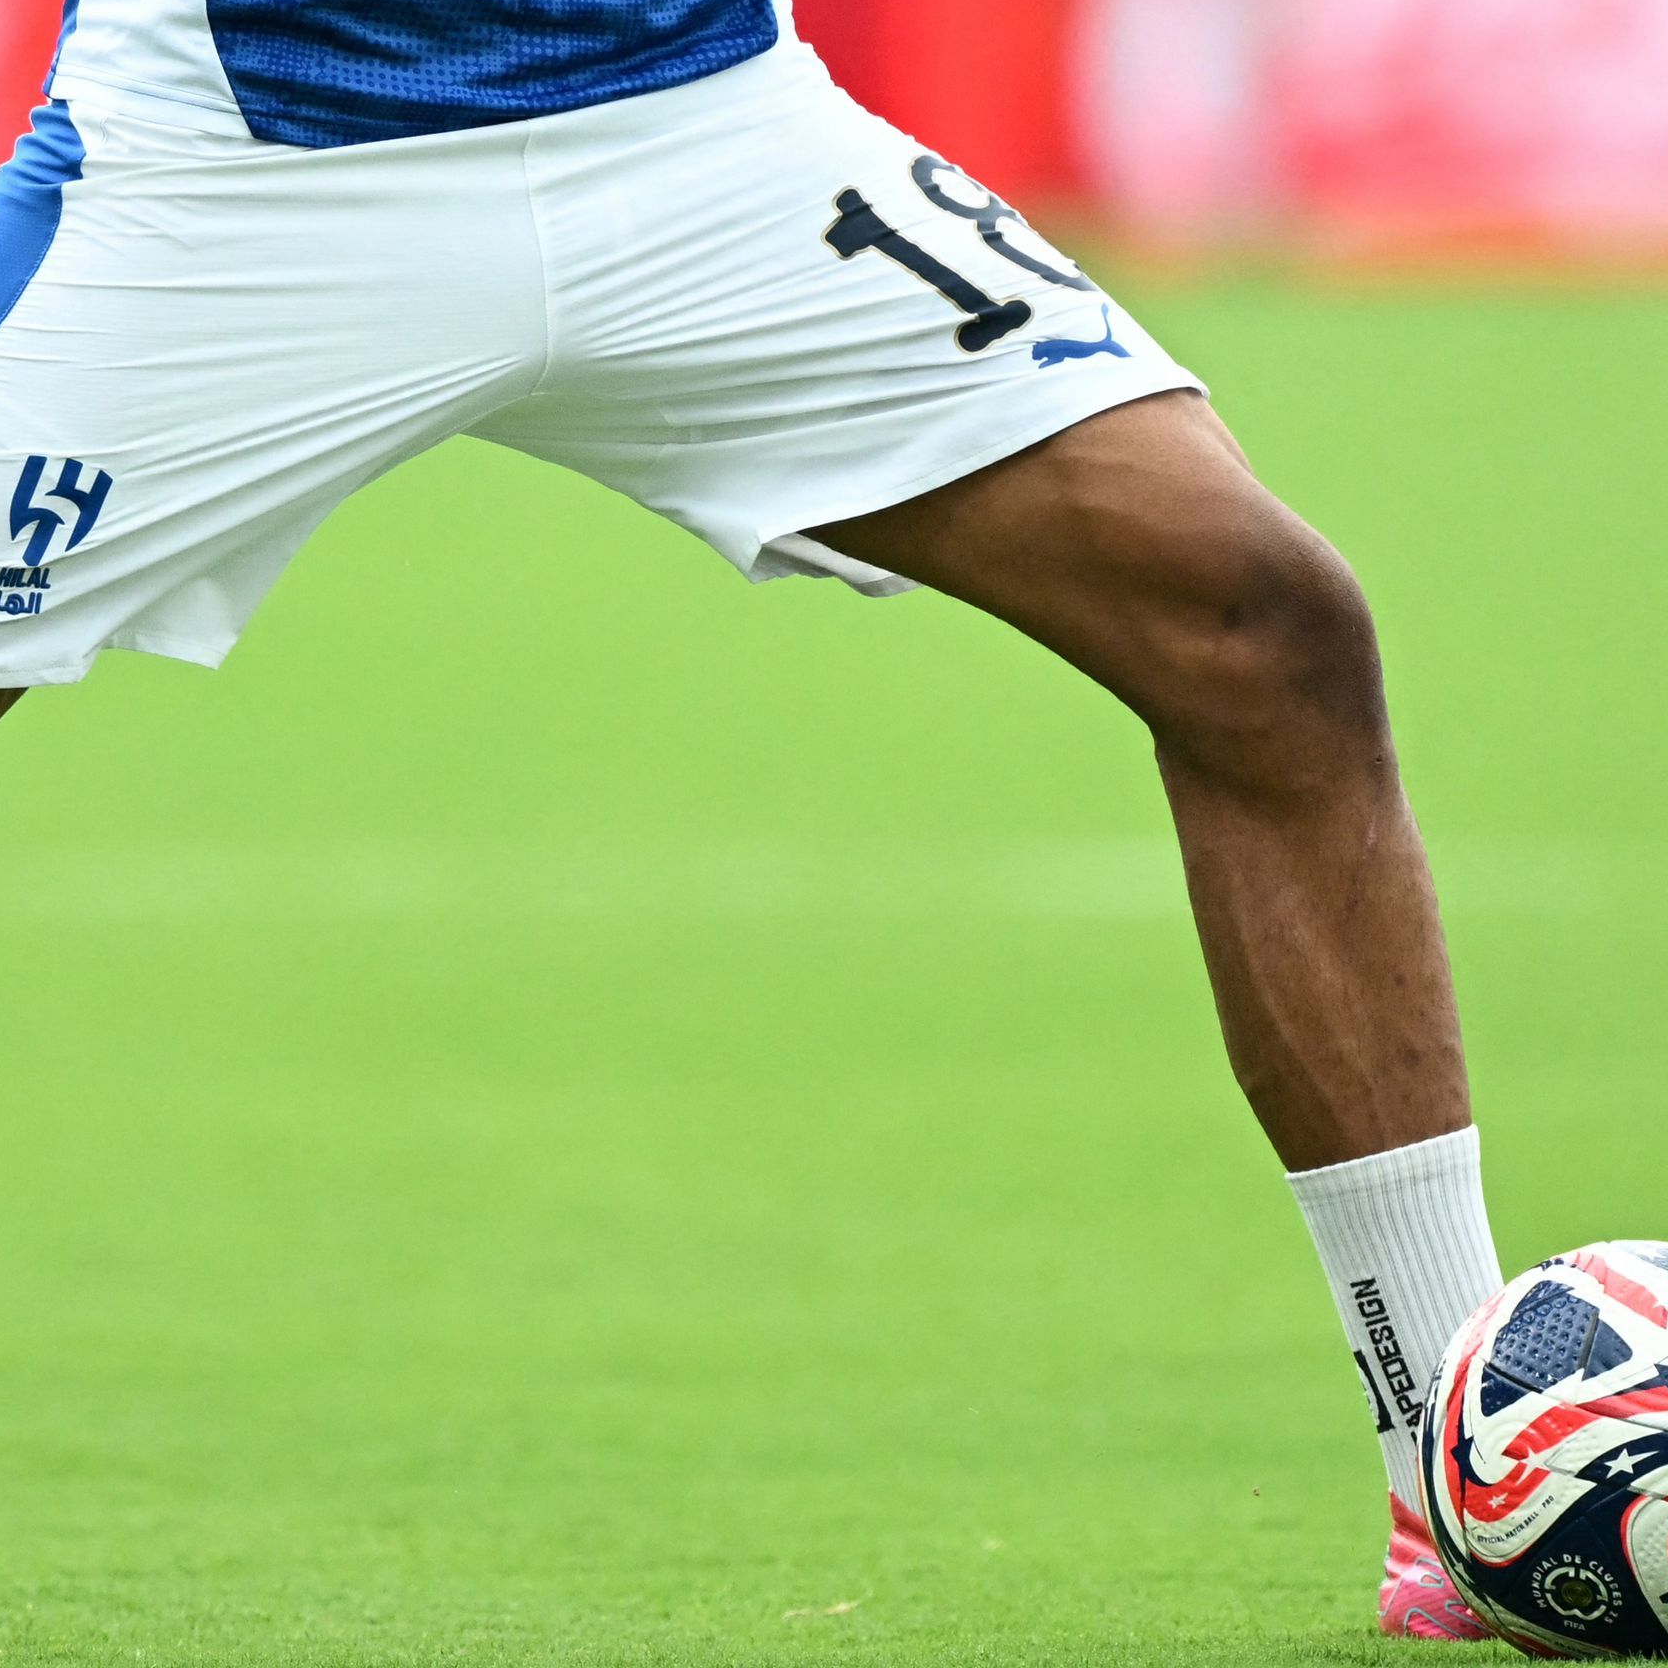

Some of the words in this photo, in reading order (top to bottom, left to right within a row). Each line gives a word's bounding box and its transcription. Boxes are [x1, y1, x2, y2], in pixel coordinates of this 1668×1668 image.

[1532, 1557, 1558, 1609] MUNDIAL
[1563, 1553, 1582, 1564] DE
[1563, 1619, 1586, 1631] FIFA
